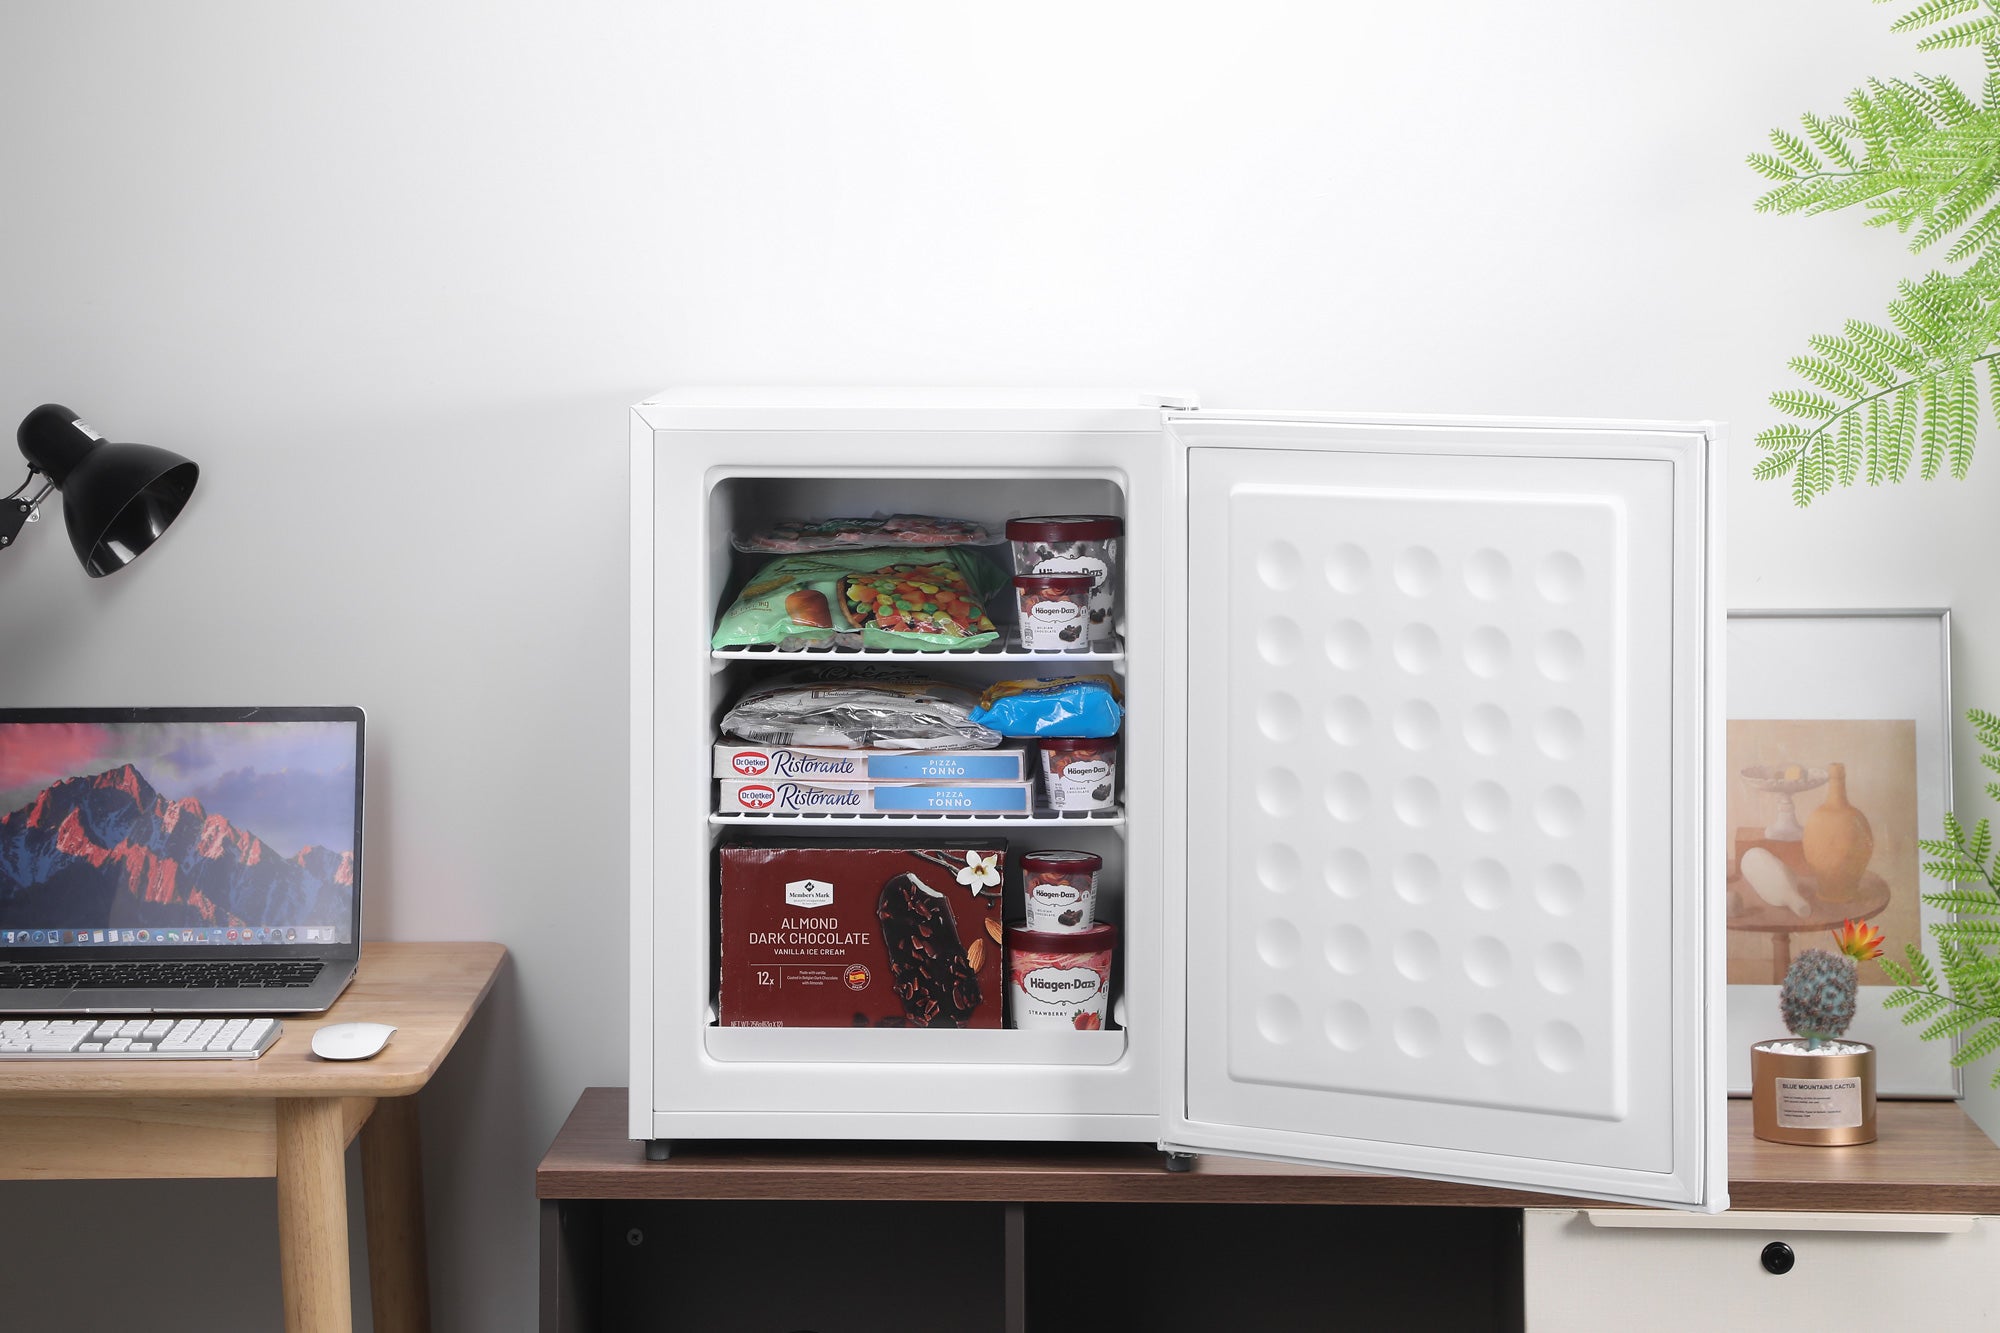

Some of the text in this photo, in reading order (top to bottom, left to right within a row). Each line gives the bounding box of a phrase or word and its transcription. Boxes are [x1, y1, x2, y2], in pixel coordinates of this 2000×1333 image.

[1035, 607, 1076, 616] Häagen-Dazs
[771, 750, 855, 777] Ristorante
[922, 767, 965, 775] TONNO
[777, 783, 861, 810] Ristorante
[928, 799, 972, 807] TONNO
[1036, 889, 1076, 899] Häagen-Dazs
[781, 918, 838, 930] ALMOND
[749, 932, 870, 945] DARK CHOCOLATE
[820, 948, 845, 956] CREAM
[756, 971, 774, 986] 12x
[1030, 978, 1096, 992] Häagen-Dazs
